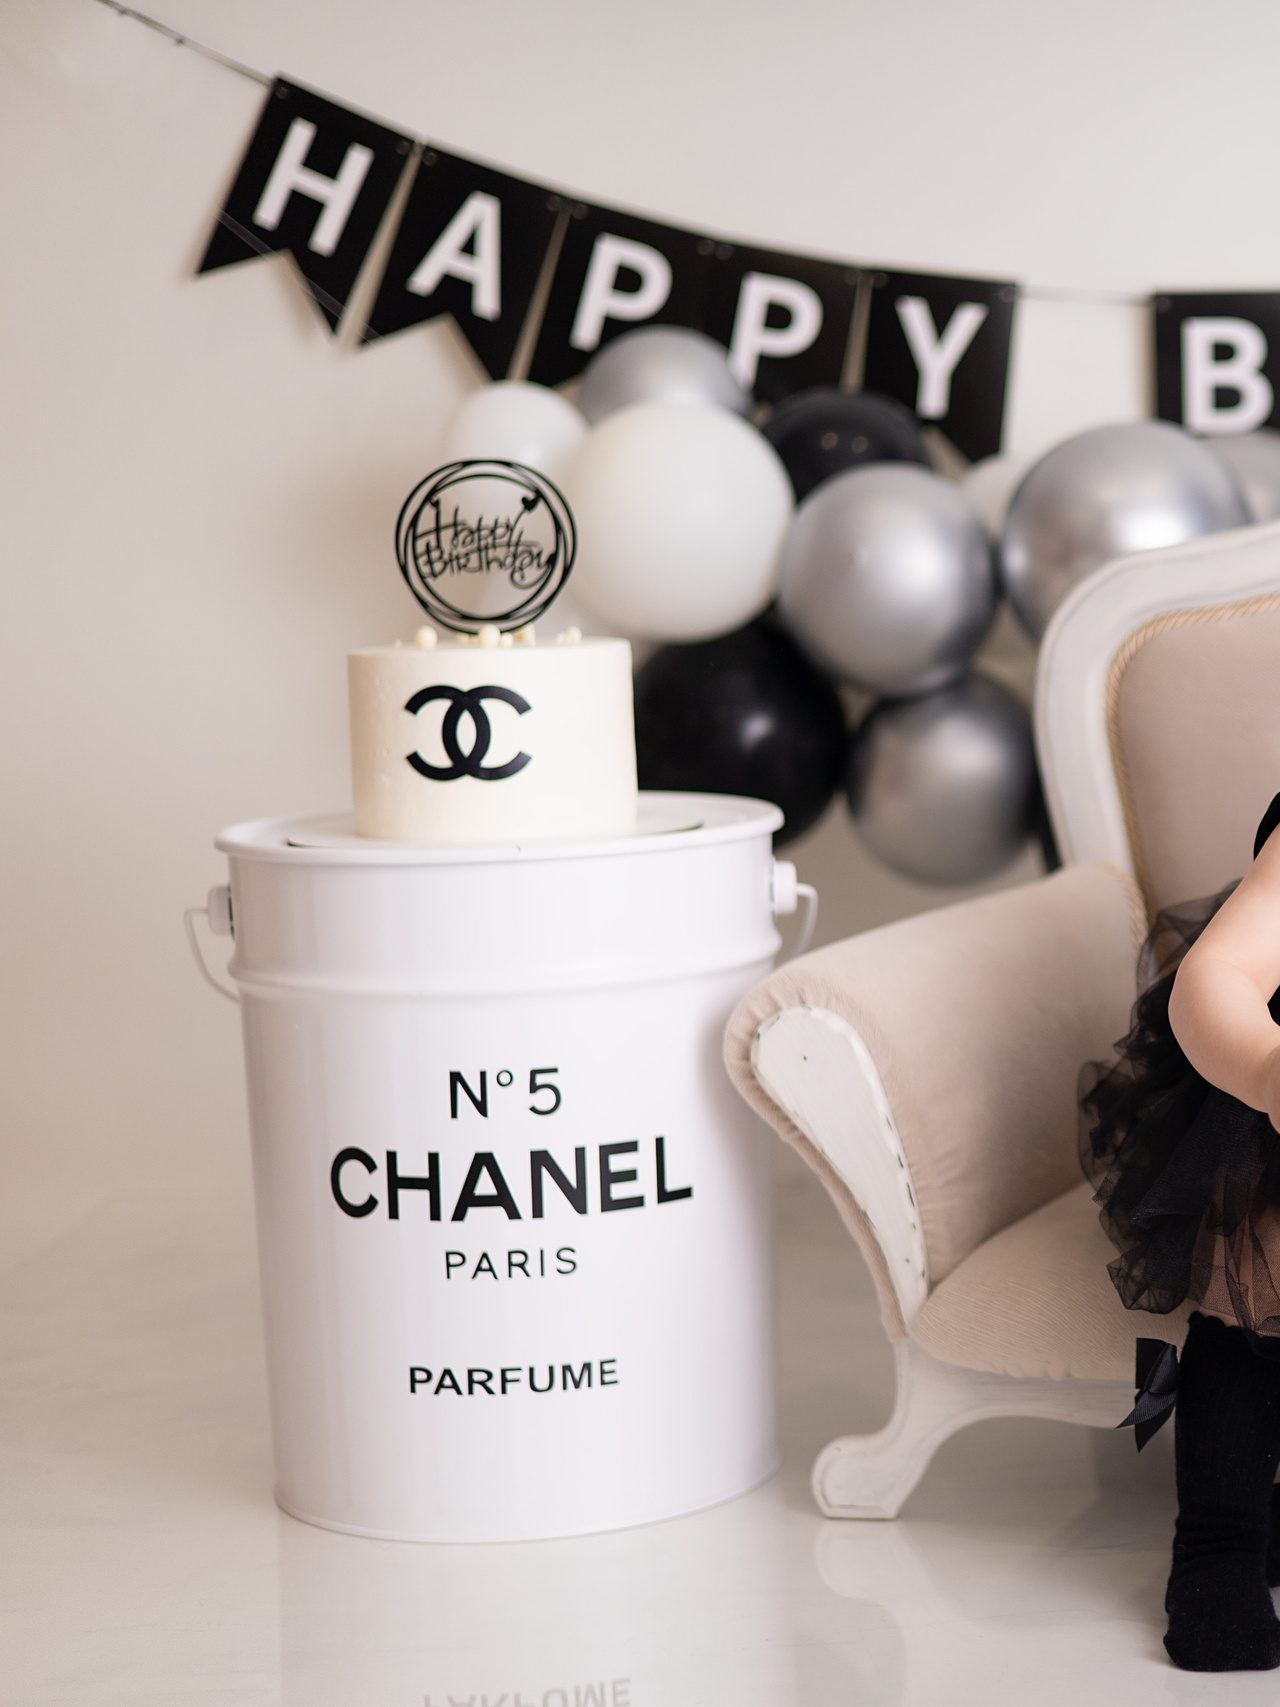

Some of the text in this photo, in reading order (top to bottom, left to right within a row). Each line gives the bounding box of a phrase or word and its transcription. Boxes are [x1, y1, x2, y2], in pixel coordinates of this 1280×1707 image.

[250, 116, 989, 420] HAPPY
[416, 499, 528, 553] Happy
[330, 1136, 693, 1222] CHANEL
[445, 1247, 578, 1280] PARIS
[409, 1359, 619, 1396] PARFUME
